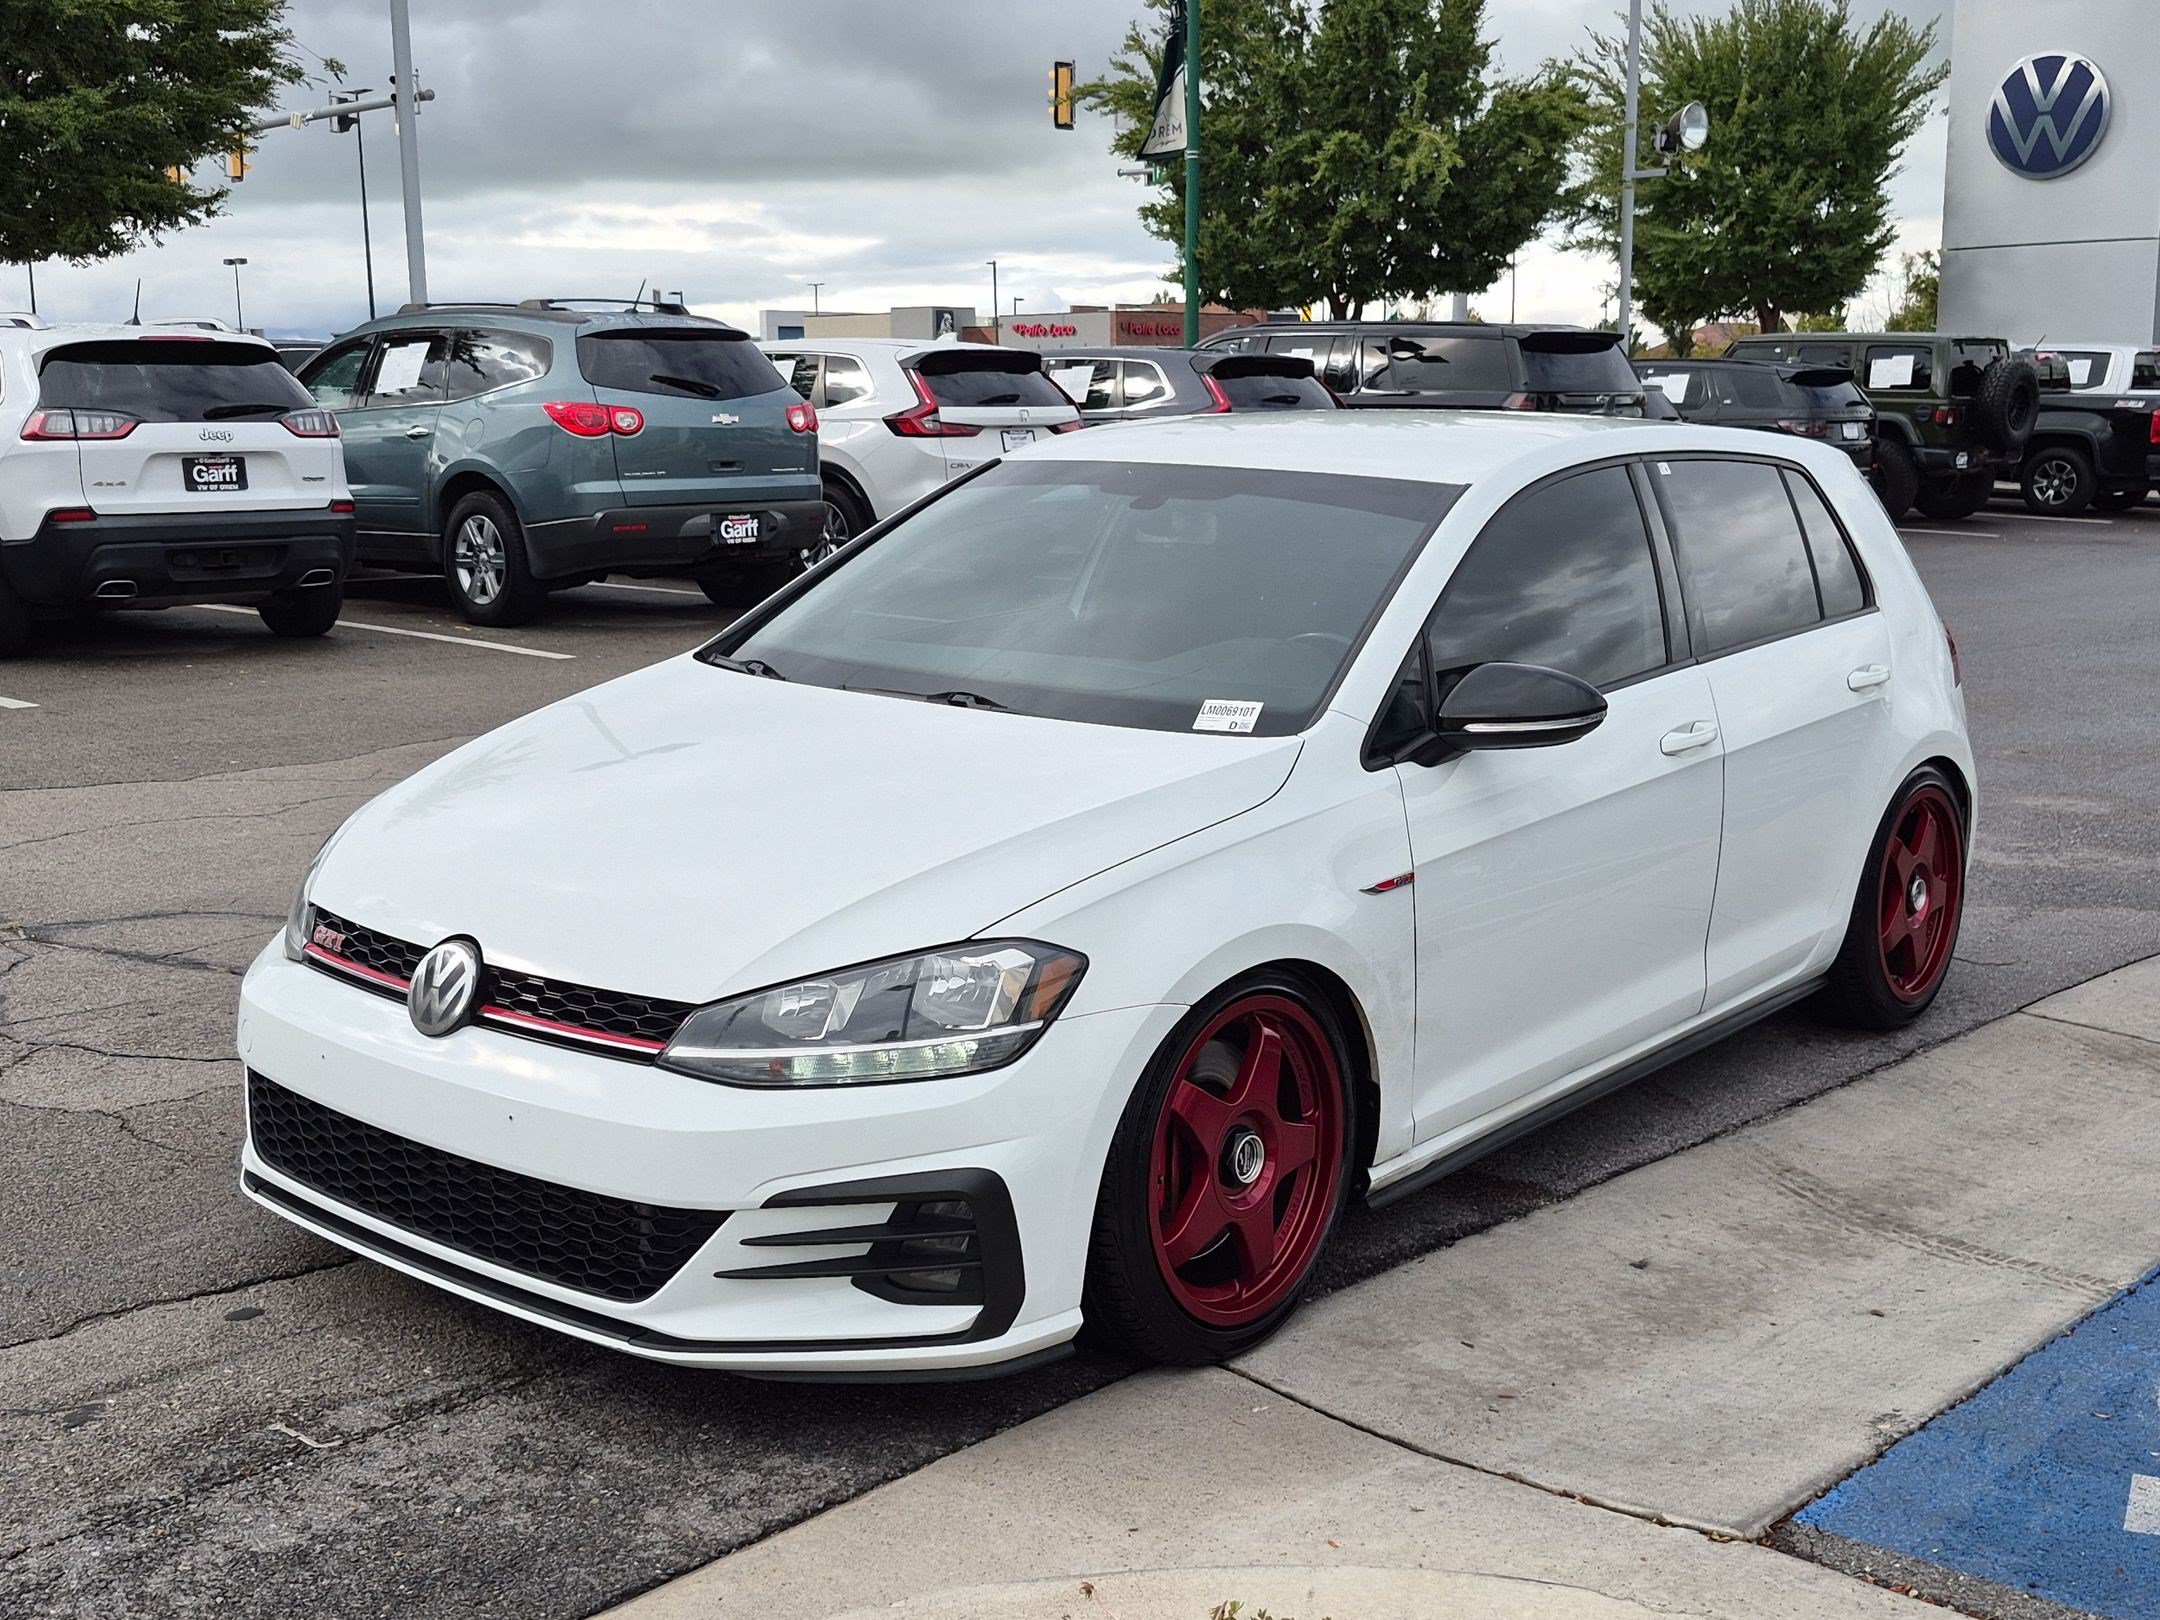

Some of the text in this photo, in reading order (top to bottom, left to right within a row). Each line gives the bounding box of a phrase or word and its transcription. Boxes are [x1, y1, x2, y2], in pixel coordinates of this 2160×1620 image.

[1018, 323, 1047, 337] Pollo
[1050, 323, 1076, 337] Loco
[1128, 321, 1155, 336] Pollo
[1156, 321, 1181, 336] Loco
[199, 428, 235, 443] Jeep
[192, 464, 238, 483] Garff
[720, 519, 759, 539] Garff
[1201, 705, 1257, 718] LM006910T
[1228, 721, 1238, 730] D
[313, 925, 347, 953] GTI
